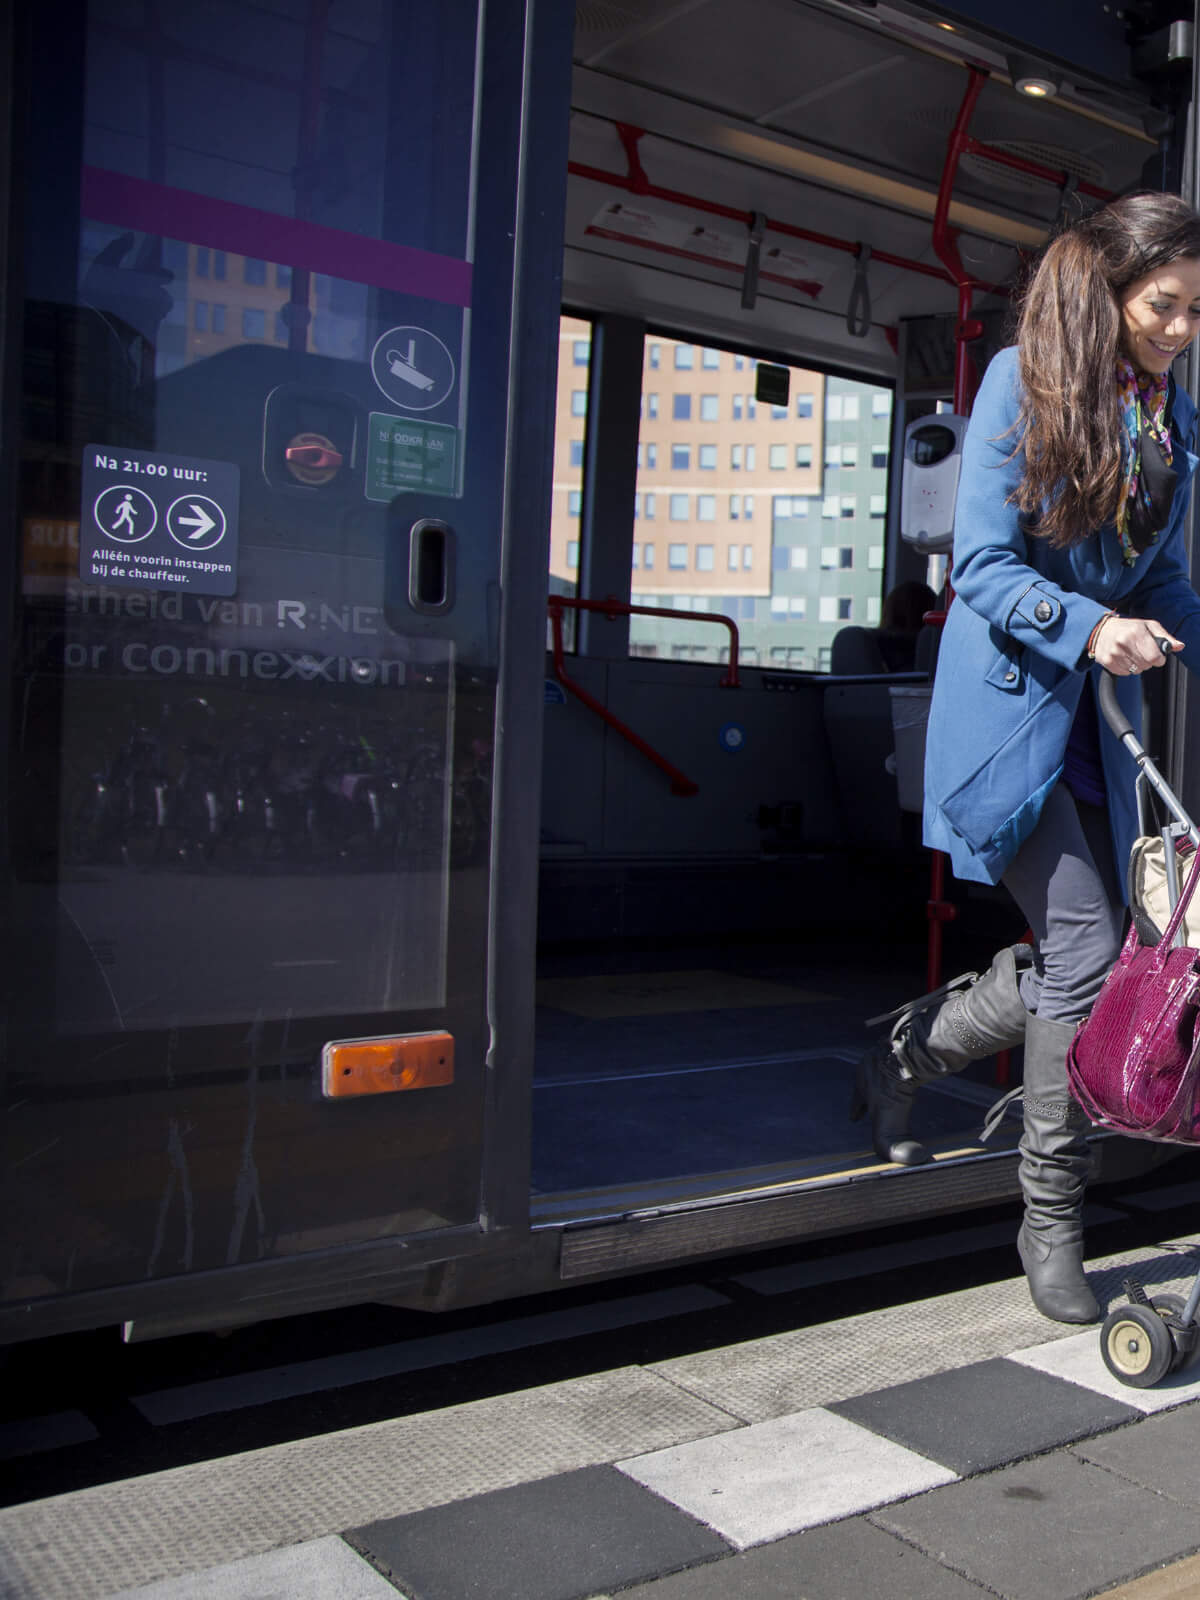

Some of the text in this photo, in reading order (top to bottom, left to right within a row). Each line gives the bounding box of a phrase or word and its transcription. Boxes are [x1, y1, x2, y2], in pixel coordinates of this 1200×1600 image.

[95, 454, 208, 482] Na 21.00 uur:
[92, 549, 232, 573] Alléén voorin instappen
[92, 563, 190, 583] bij de chauffeur.
[196, 600, 263, 628] van
[120, 642, 407, 686] connexxion
